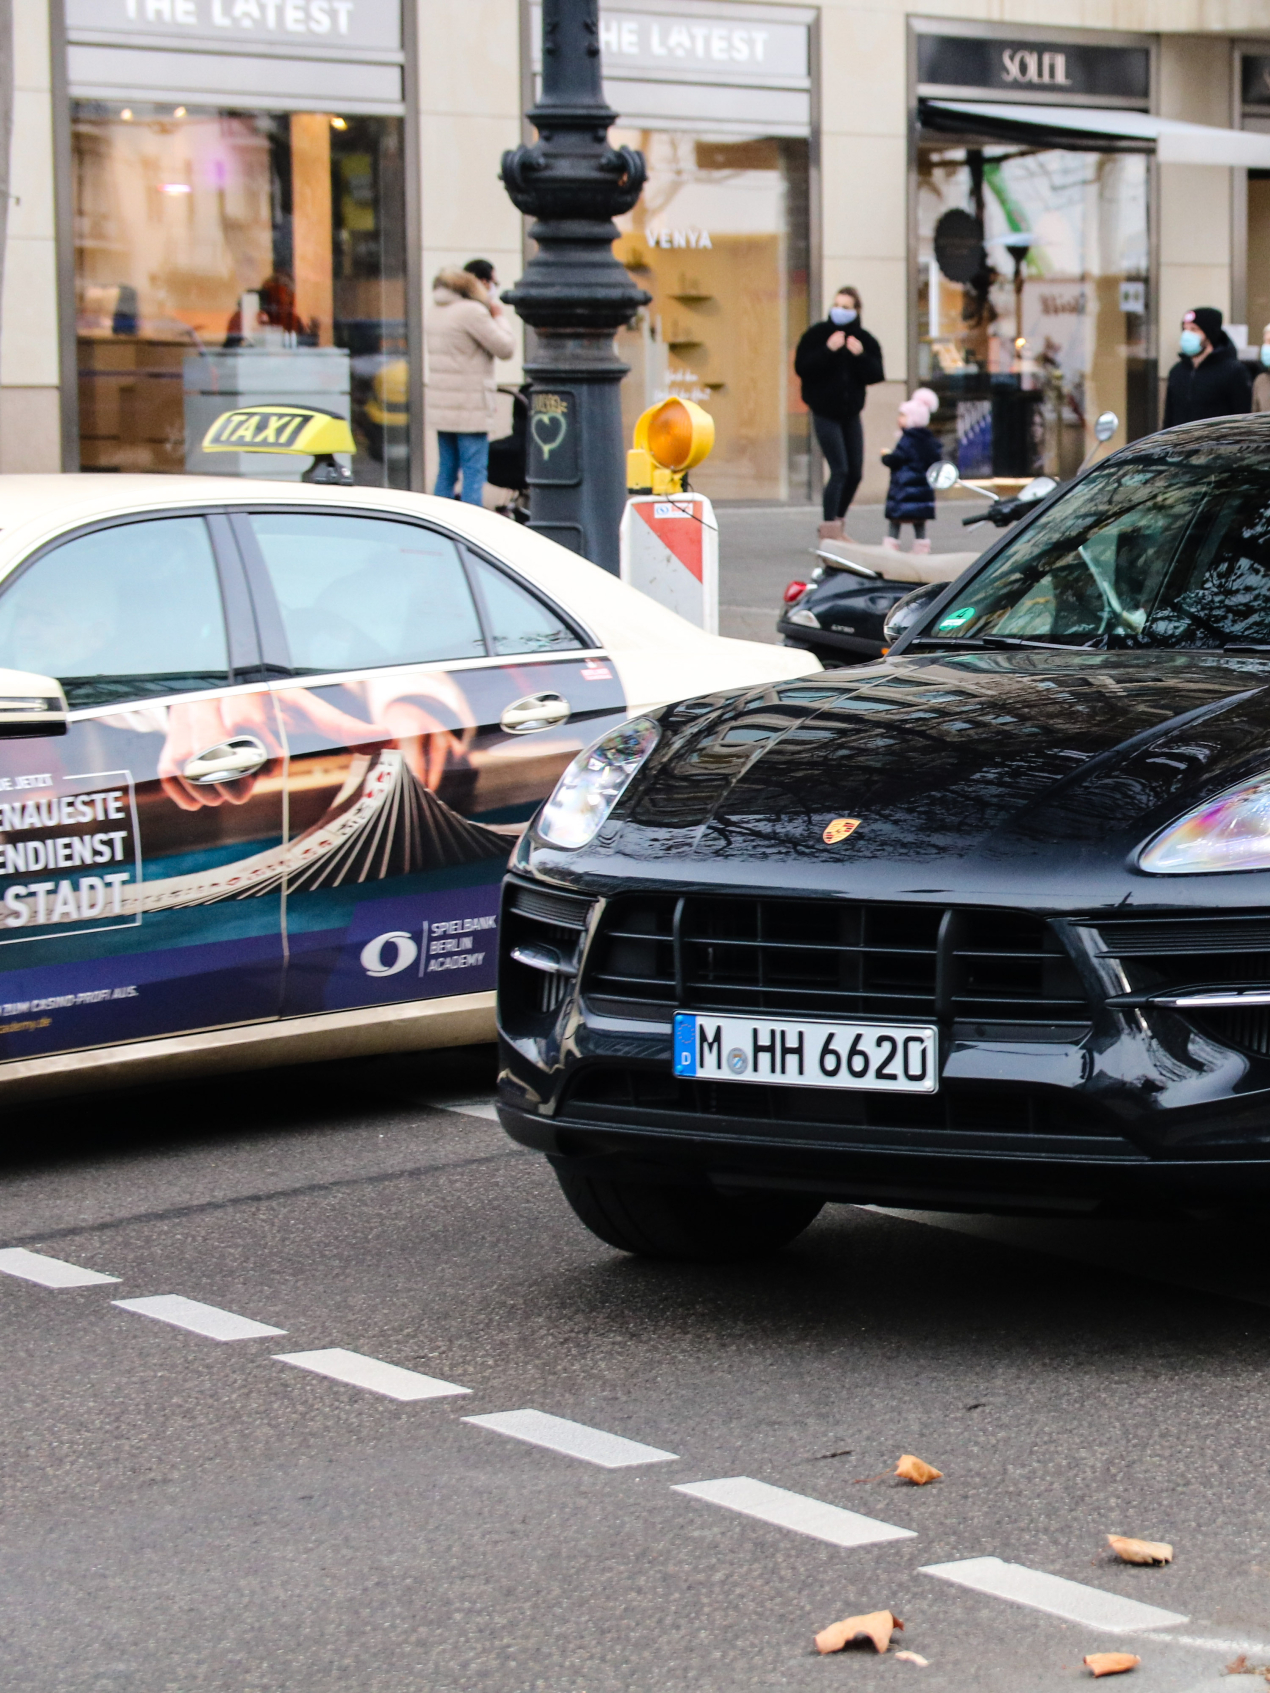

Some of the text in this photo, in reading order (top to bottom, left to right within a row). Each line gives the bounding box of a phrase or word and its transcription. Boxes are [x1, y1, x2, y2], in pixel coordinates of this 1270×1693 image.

[125, 0, 354, 36] THE LATEST
[600, 20, 769, 62] HE LATEST
[1001, 48, 1073, 85] SOLEIL
[645, 228, 713, 249] VENYA
[219, 413, 304, 444] TAXI
[955, 607, 970, 620] 4
[0, 791, 126, 832] NAUESTE
[4, 872, 131, 928] STADT
[430, 914, 498, 937] SPIELBANK
[429, 936, 474, 955] BERLIN
[426, 951, 487, 973] ACADEMY
[680, 1050, 692, 1067] D
[698, 1022, 928, 1082] M HH 6620
